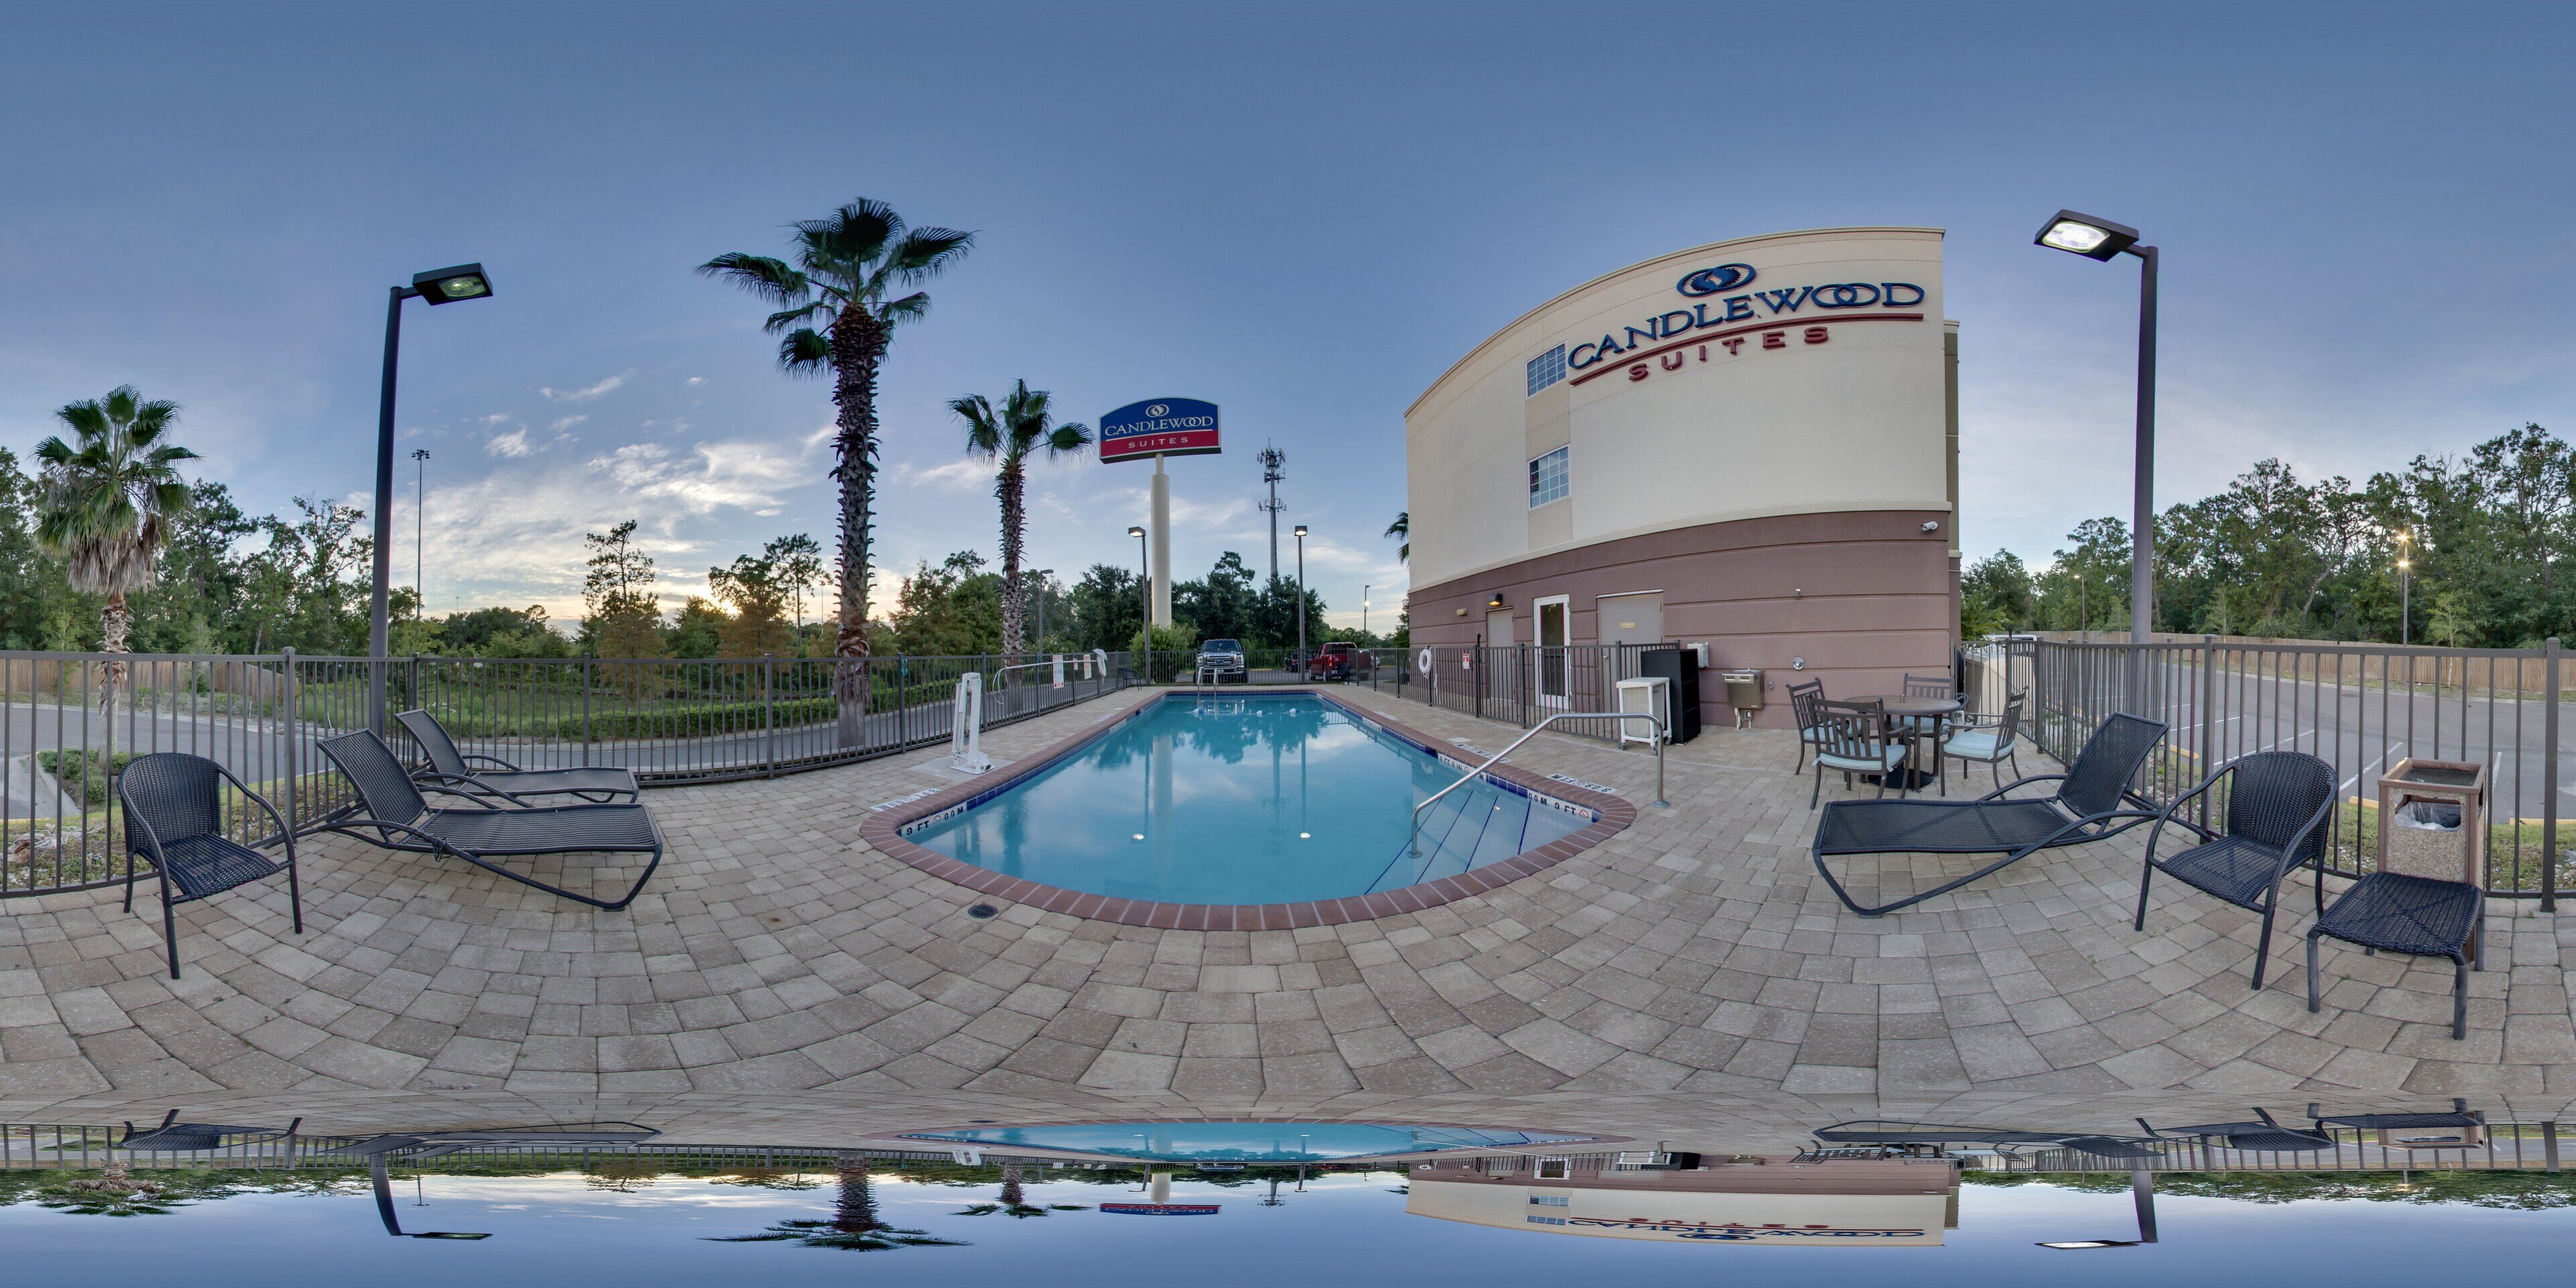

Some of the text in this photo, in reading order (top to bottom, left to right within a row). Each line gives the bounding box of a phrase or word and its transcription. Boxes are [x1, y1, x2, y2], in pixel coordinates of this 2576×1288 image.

[1568, 282, 1925, 370] CANDLEWOOD
[1628, 327, 1829, 382] SUITES
[1105, 416, 1214, 436] CANDLEWOOD
[1128, 437, 1189, 448] SUITES
